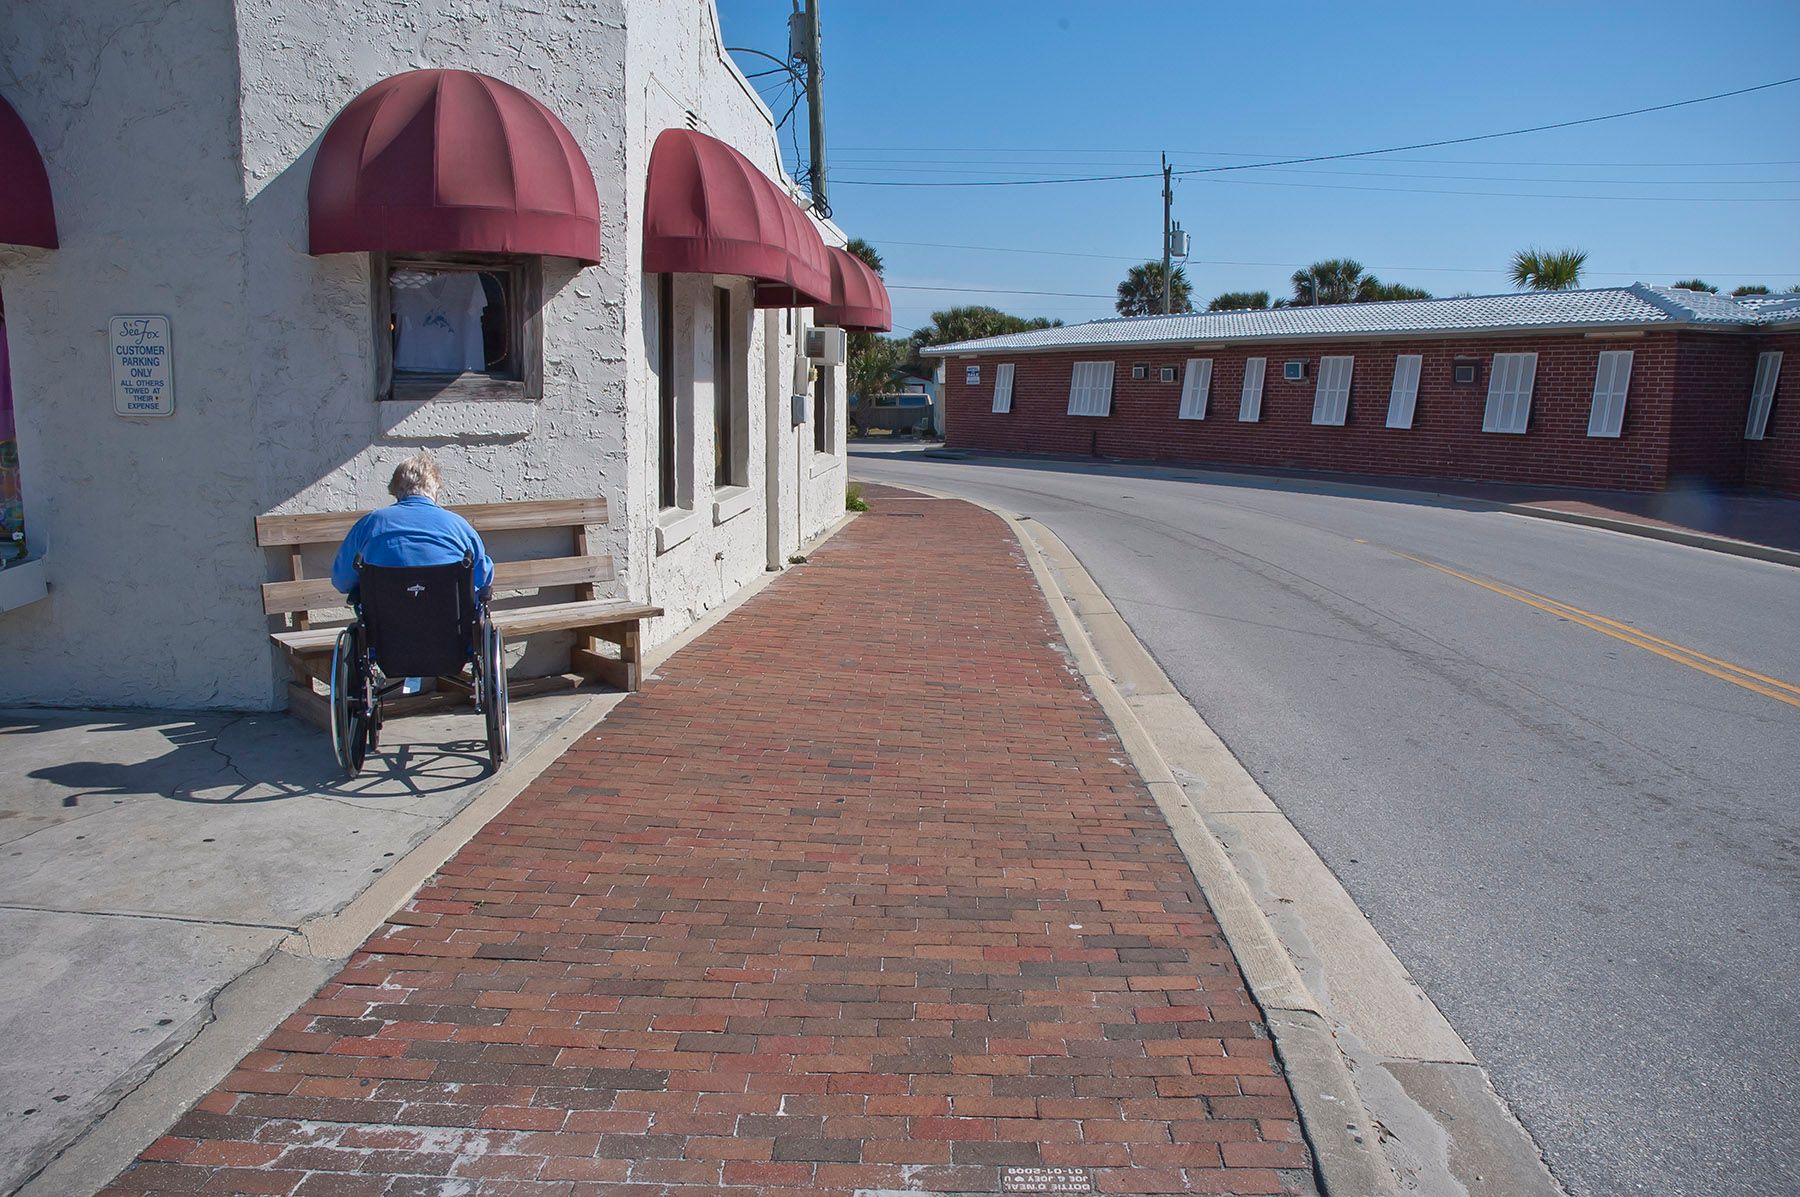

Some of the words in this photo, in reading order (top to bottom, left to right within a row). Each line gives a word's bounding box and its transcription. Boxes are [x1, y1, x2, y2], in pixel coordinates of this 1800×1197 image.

[116, 345, 165, 355] CUSTOMER
[122, 357, 160, 366] PARKING
[130, 368, 152, 377] ONLY
